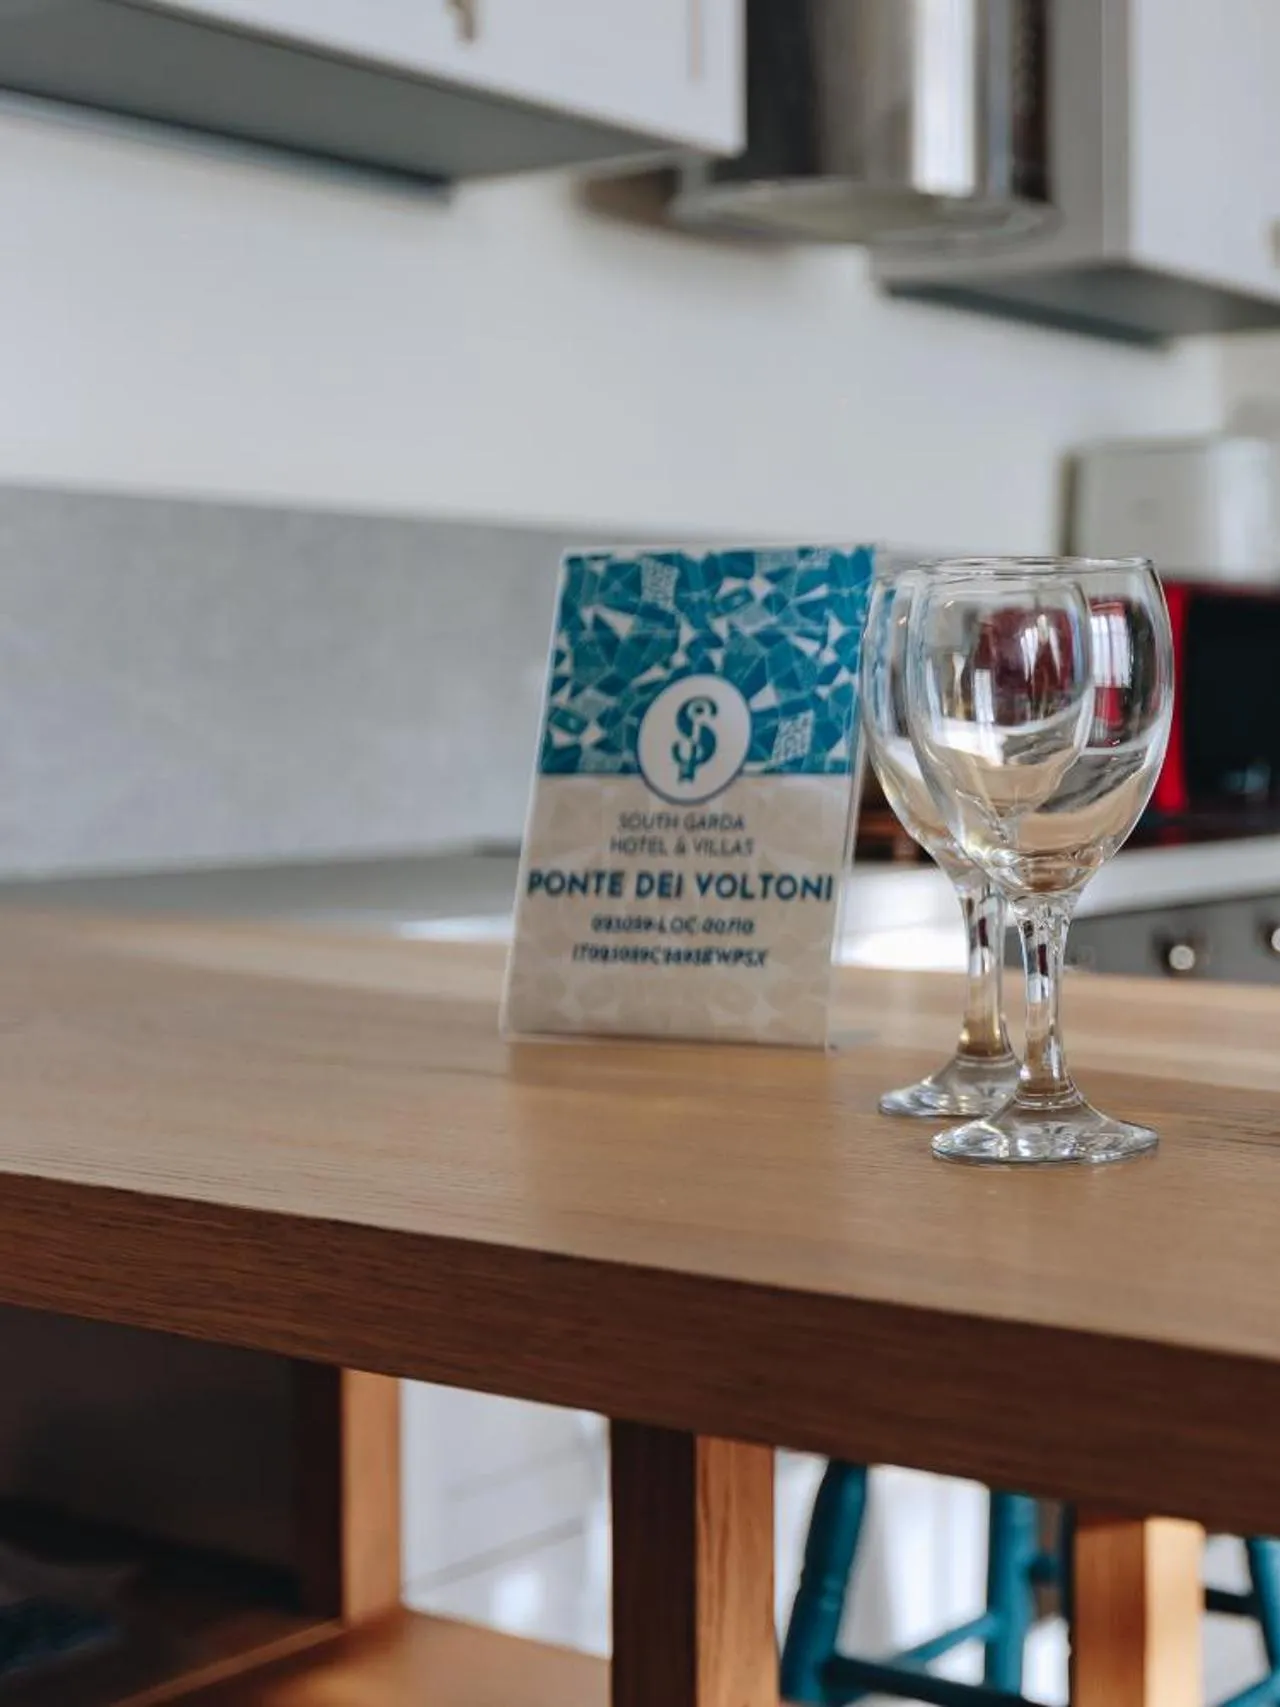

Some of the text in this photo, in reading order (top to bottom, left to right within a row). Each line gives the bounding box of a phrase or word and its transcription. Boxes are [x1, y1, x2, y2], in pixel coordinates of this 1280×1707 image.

[617, 812, 745, 833] SOUTH GARDA
[609, 837, 669, 857] HOTEL
[526, 868, 835, 902] PONTE DEI VOLTONI
